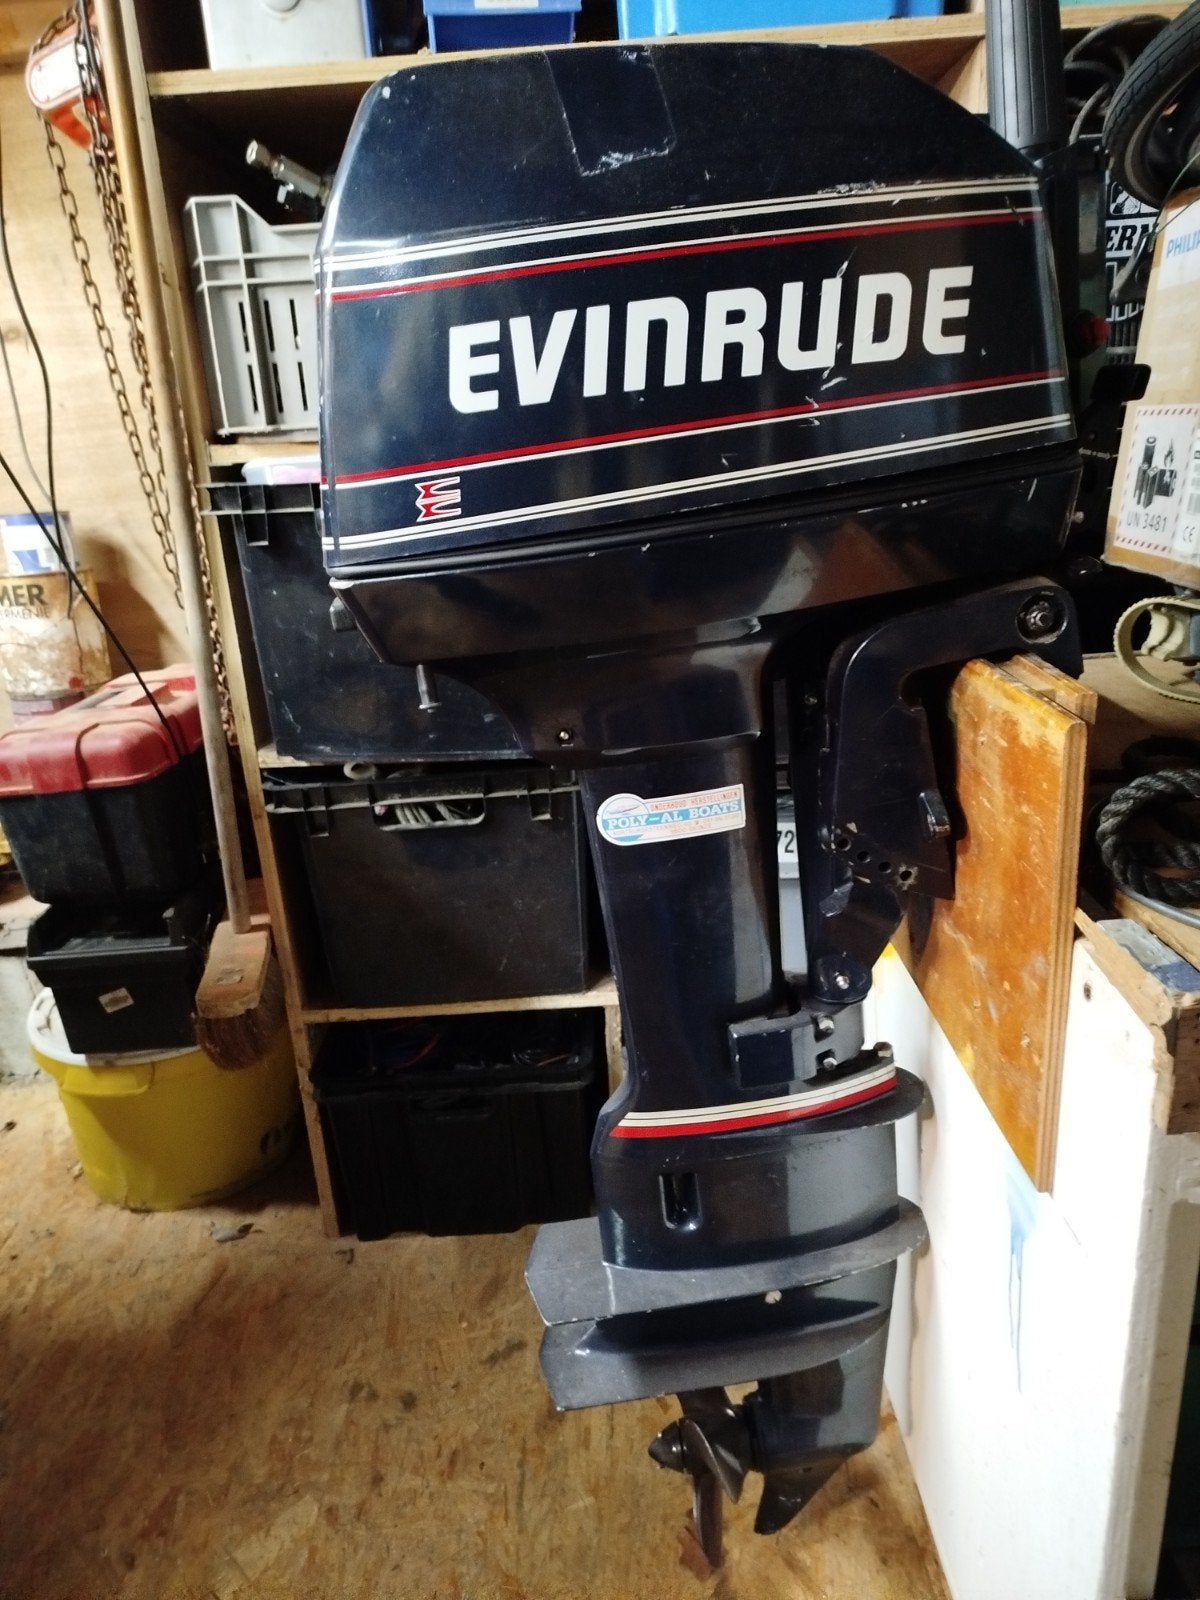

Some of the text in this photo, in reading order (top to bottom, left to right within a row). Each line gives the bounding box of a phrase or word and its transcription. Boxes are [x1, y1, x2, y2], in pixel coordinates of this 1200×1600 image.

[448, 265, 974, 415] EVINRUDE
[1127, 511, 1168, 532] UN 3481
[689, 802, 739, 818] BOATS
